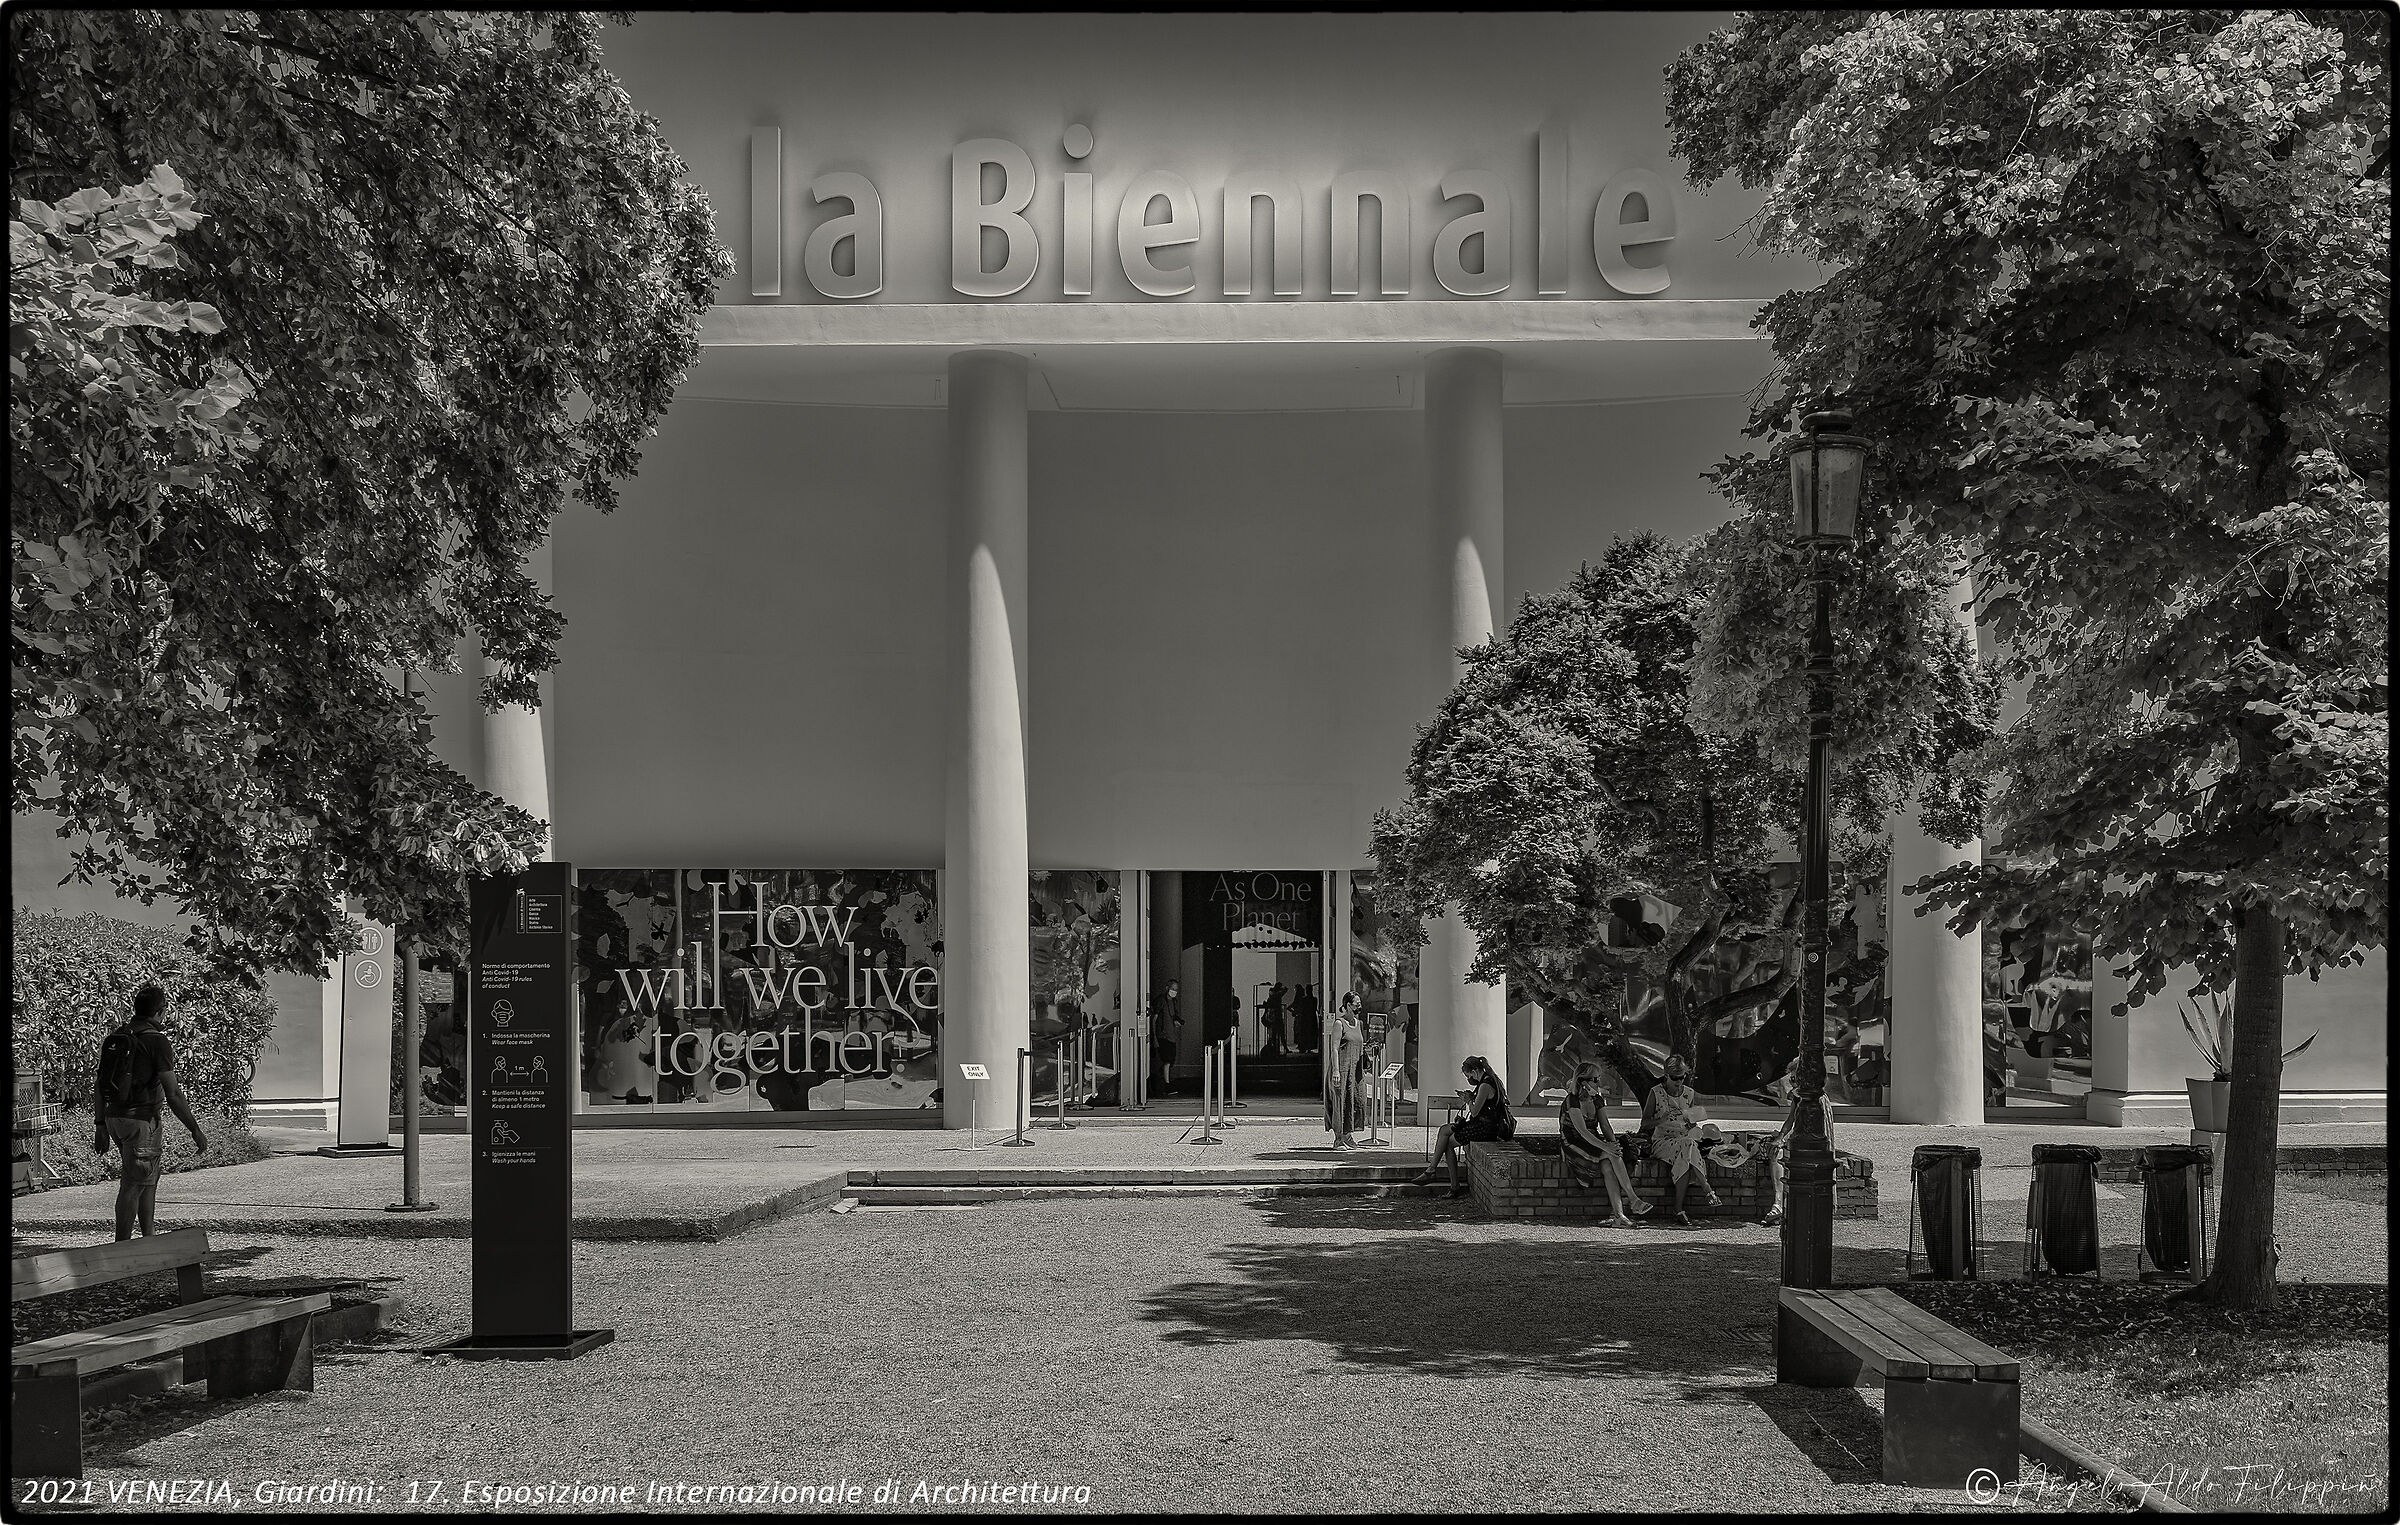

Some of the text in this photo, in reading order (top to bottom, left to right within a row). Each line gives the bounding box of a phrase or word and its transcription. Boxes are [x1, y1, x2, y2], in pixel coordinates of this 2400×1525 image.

[751, 122, 1676, 297] la Biennale
[708, 881, 859, 948] How
[1209, 872, 1312, 902] As One
[1223, 901, 1300, 931] Planet
[615, 941, 938, 1011] will we live
